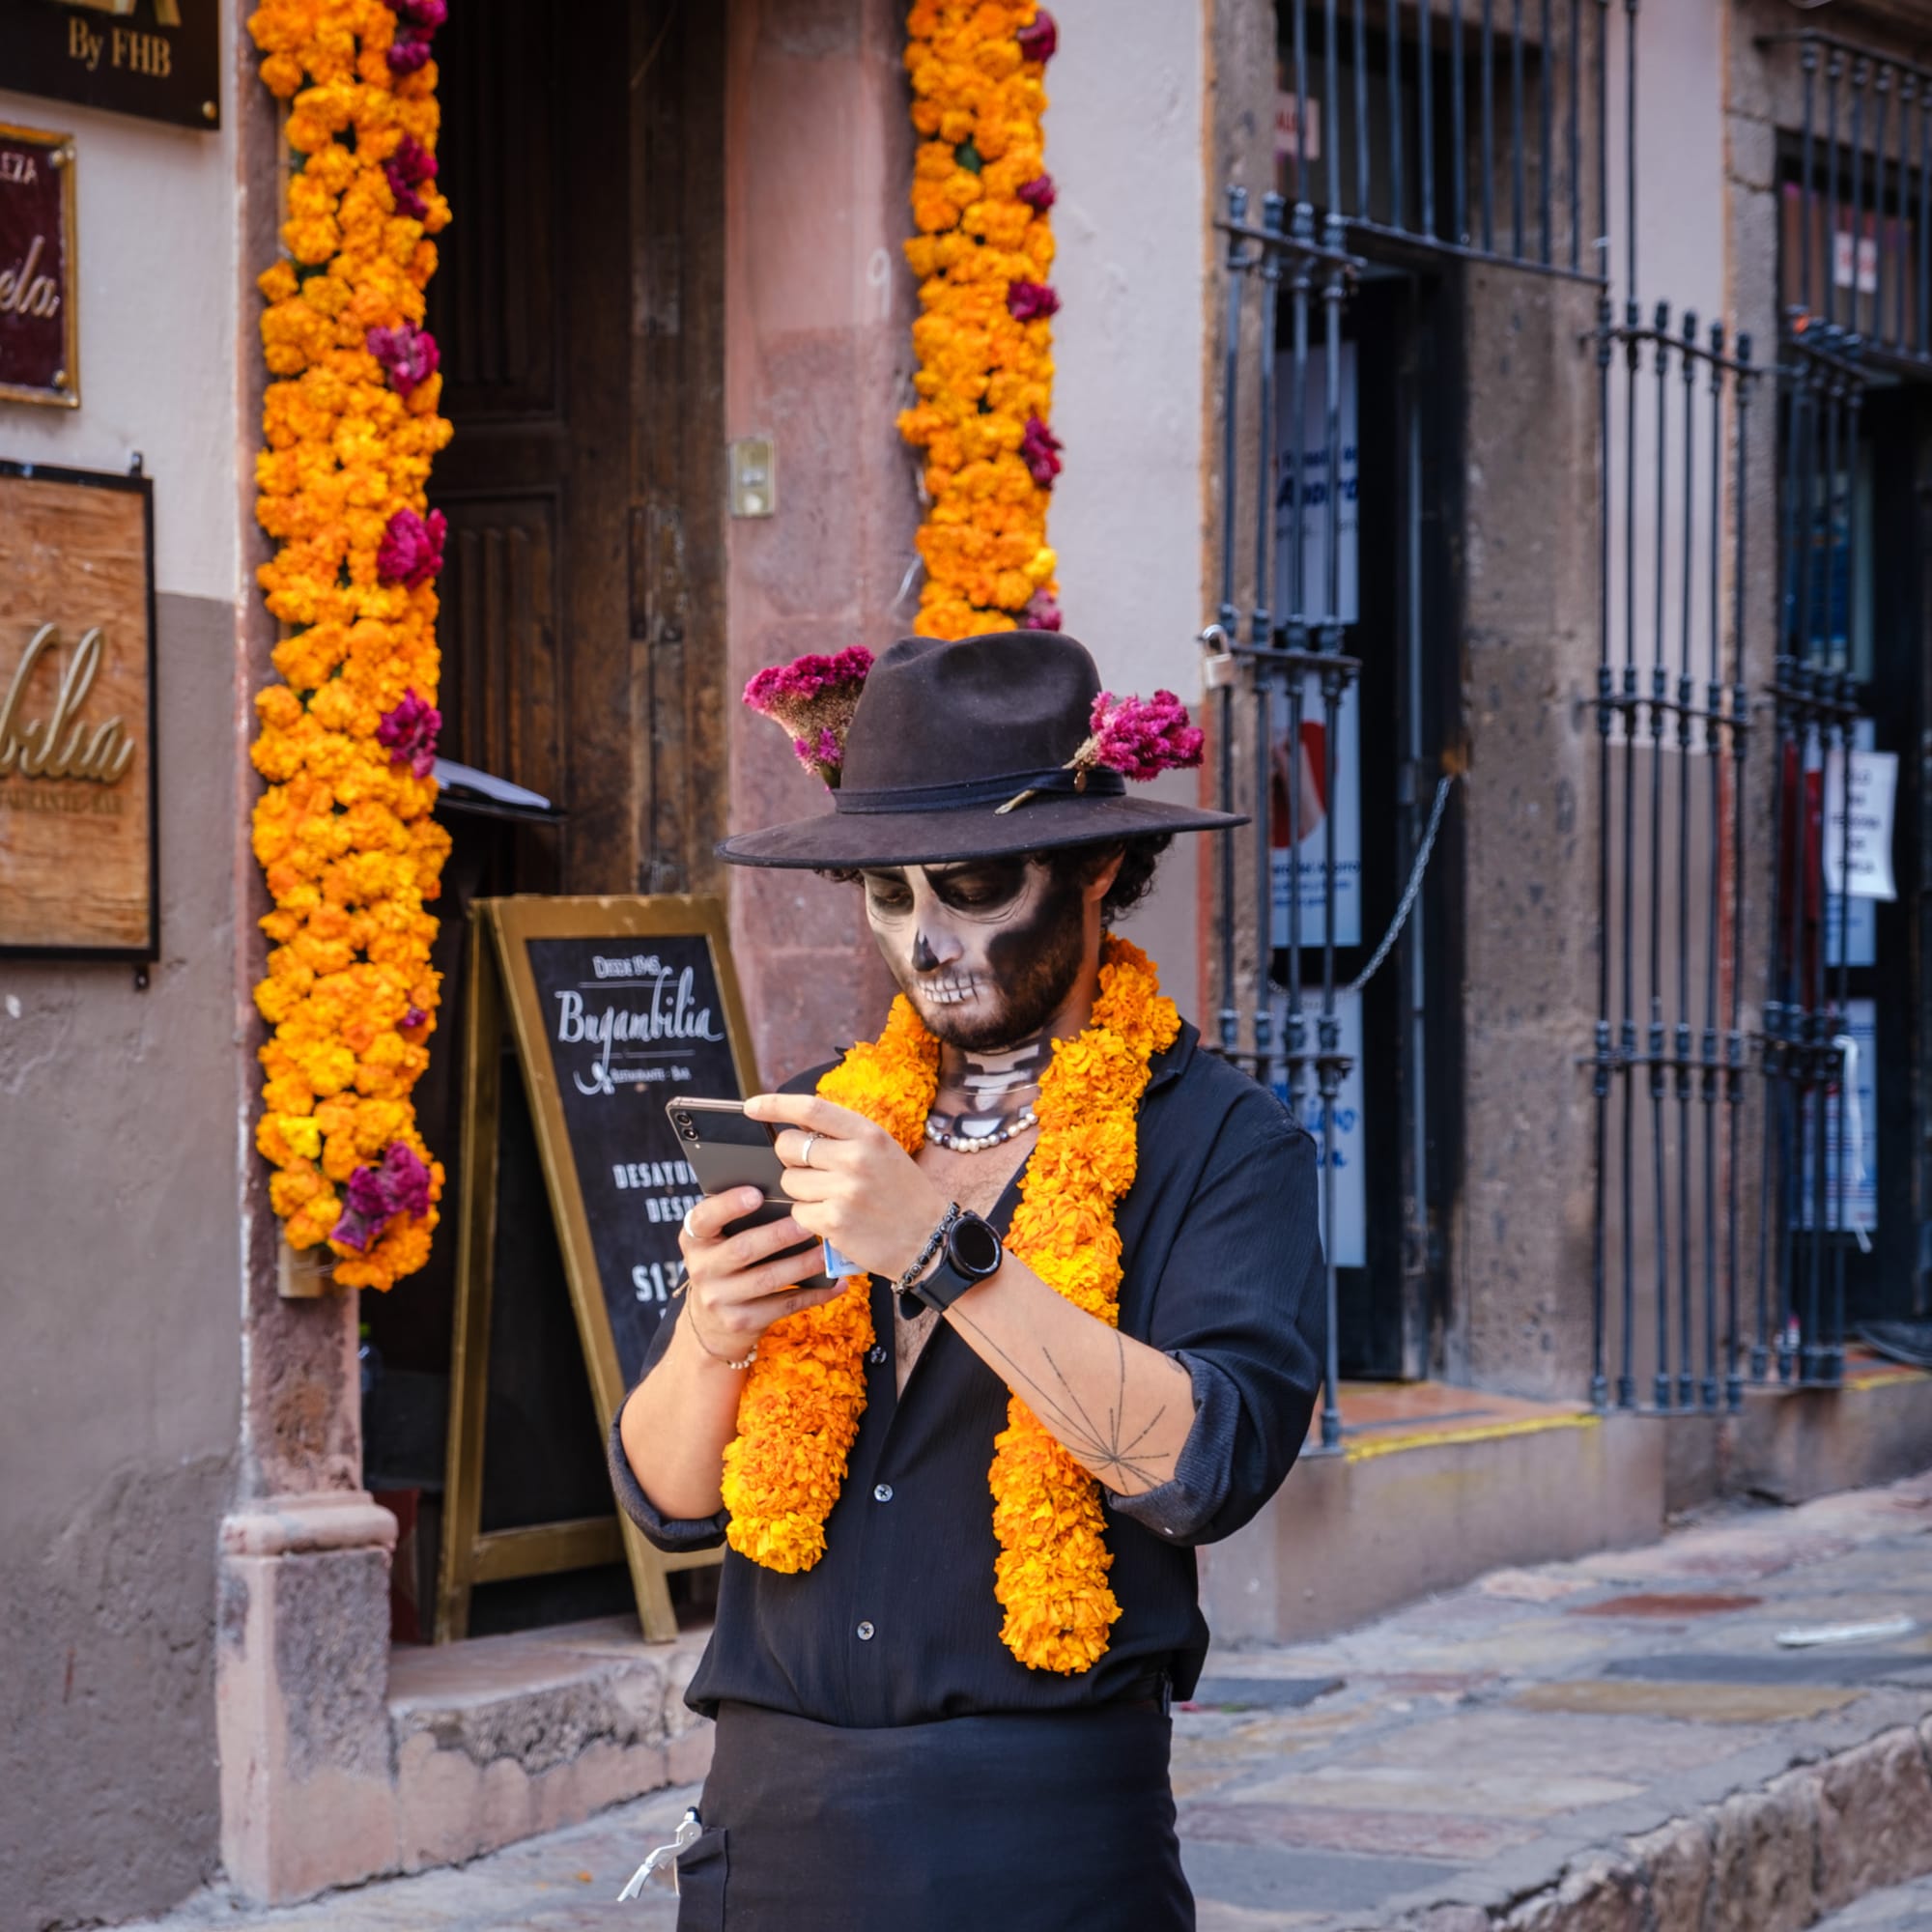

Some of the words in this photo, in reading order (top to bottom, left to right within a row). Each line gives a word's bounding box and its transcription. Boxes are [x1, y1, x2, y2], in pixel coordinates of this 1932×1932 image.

[69, 16, 102, 71] By
[111, 26, 172, 78] FHB
[554, 966, 724, 1094] Bugambilia
